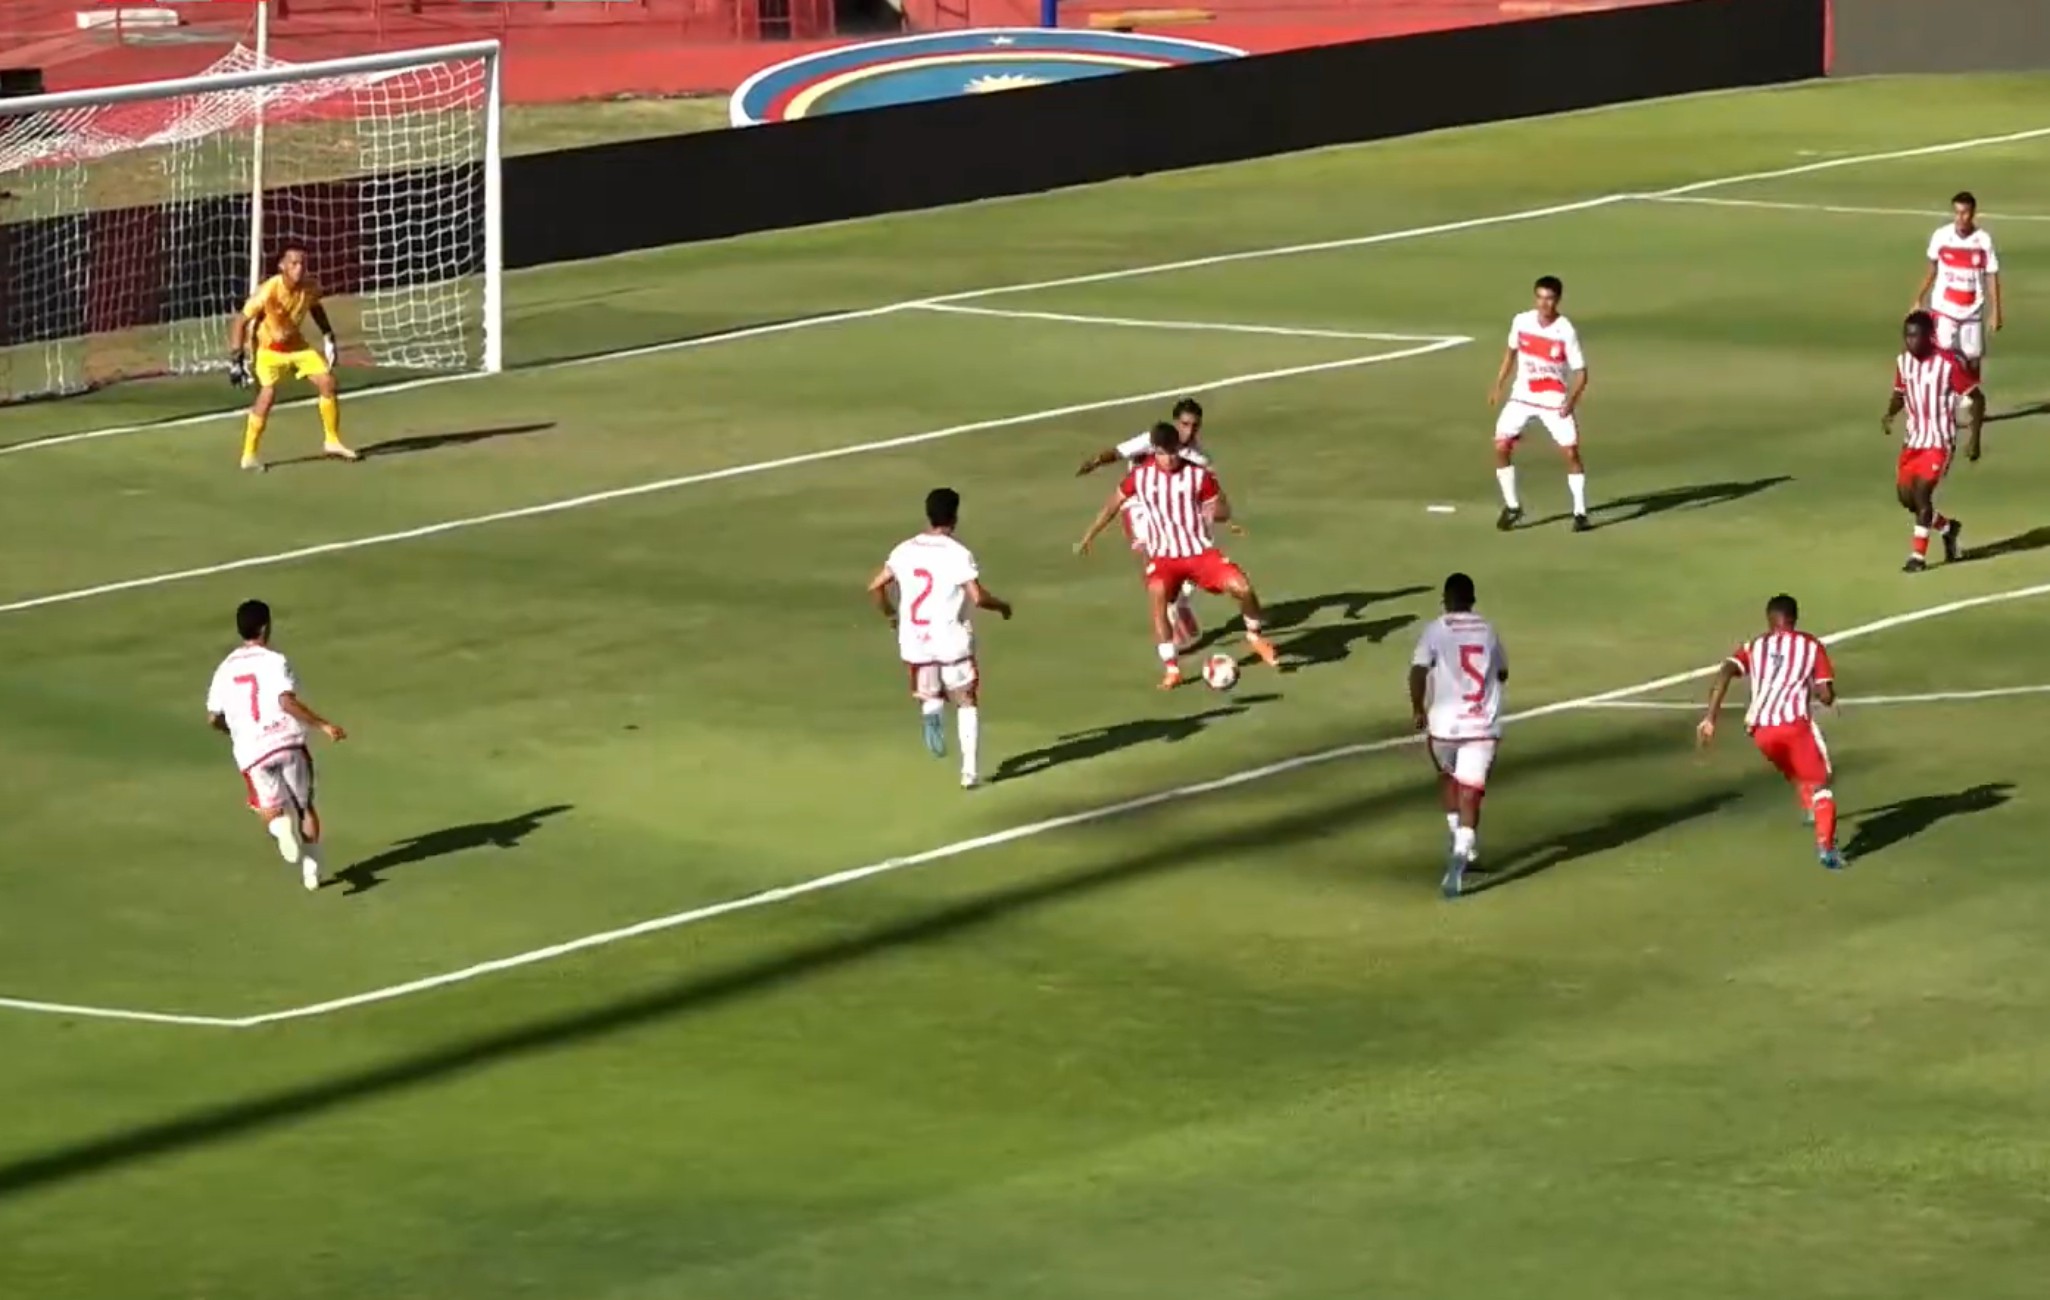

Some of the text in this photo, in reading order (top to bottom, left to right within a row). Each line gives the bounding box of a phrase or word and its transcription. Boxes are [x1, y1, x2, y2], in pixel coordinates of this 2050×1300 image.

[911, 568, 933, 626] 2
[234, 673, 260, 723] 7
[1459, 645, 1486, 703] 5
